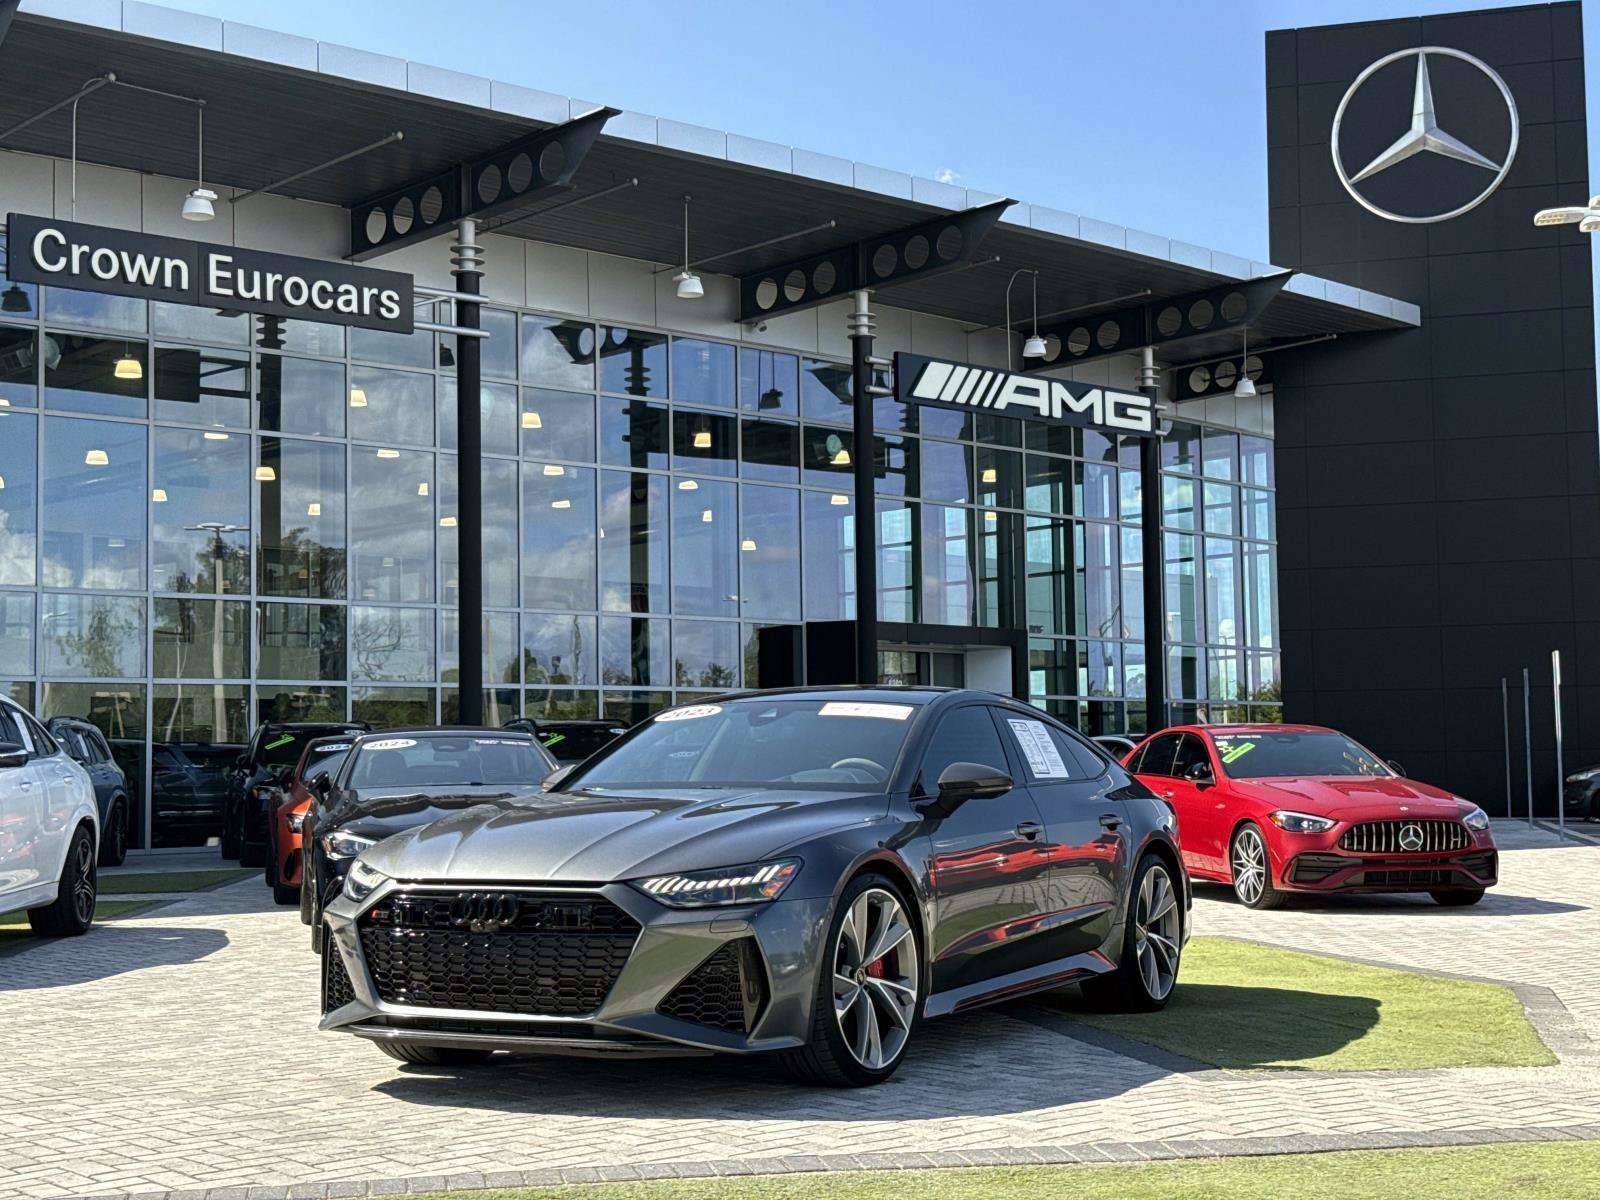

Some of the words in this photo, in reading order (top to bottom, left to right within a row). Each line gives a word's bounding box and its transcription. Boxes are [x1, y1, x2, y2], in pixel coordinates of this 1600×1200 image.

[33, 228, 190, 290] Crown
[208, 252, 401, 320] Eurocars
[993, 374, 1152, 432] AMG
